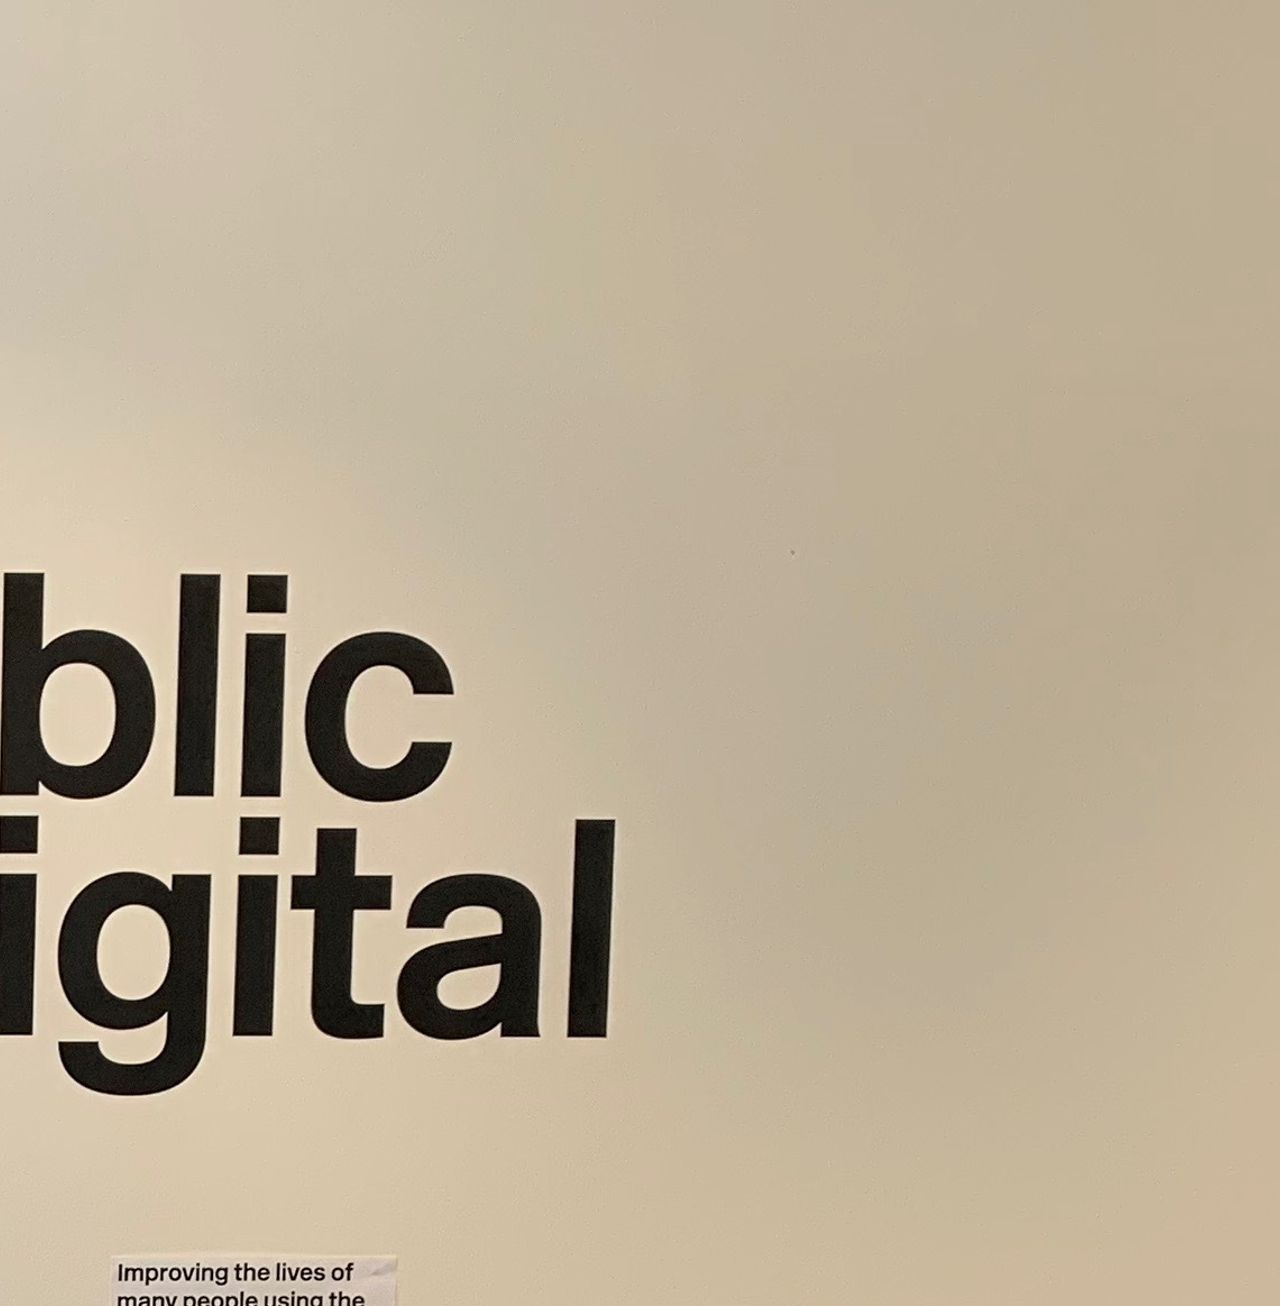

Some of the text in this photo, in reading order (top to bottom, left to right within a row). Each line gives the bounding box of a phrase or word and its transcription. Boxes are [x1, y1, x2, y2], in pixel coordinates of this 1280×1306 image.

[118, 1263, 354, 1285] Improving the lives of
